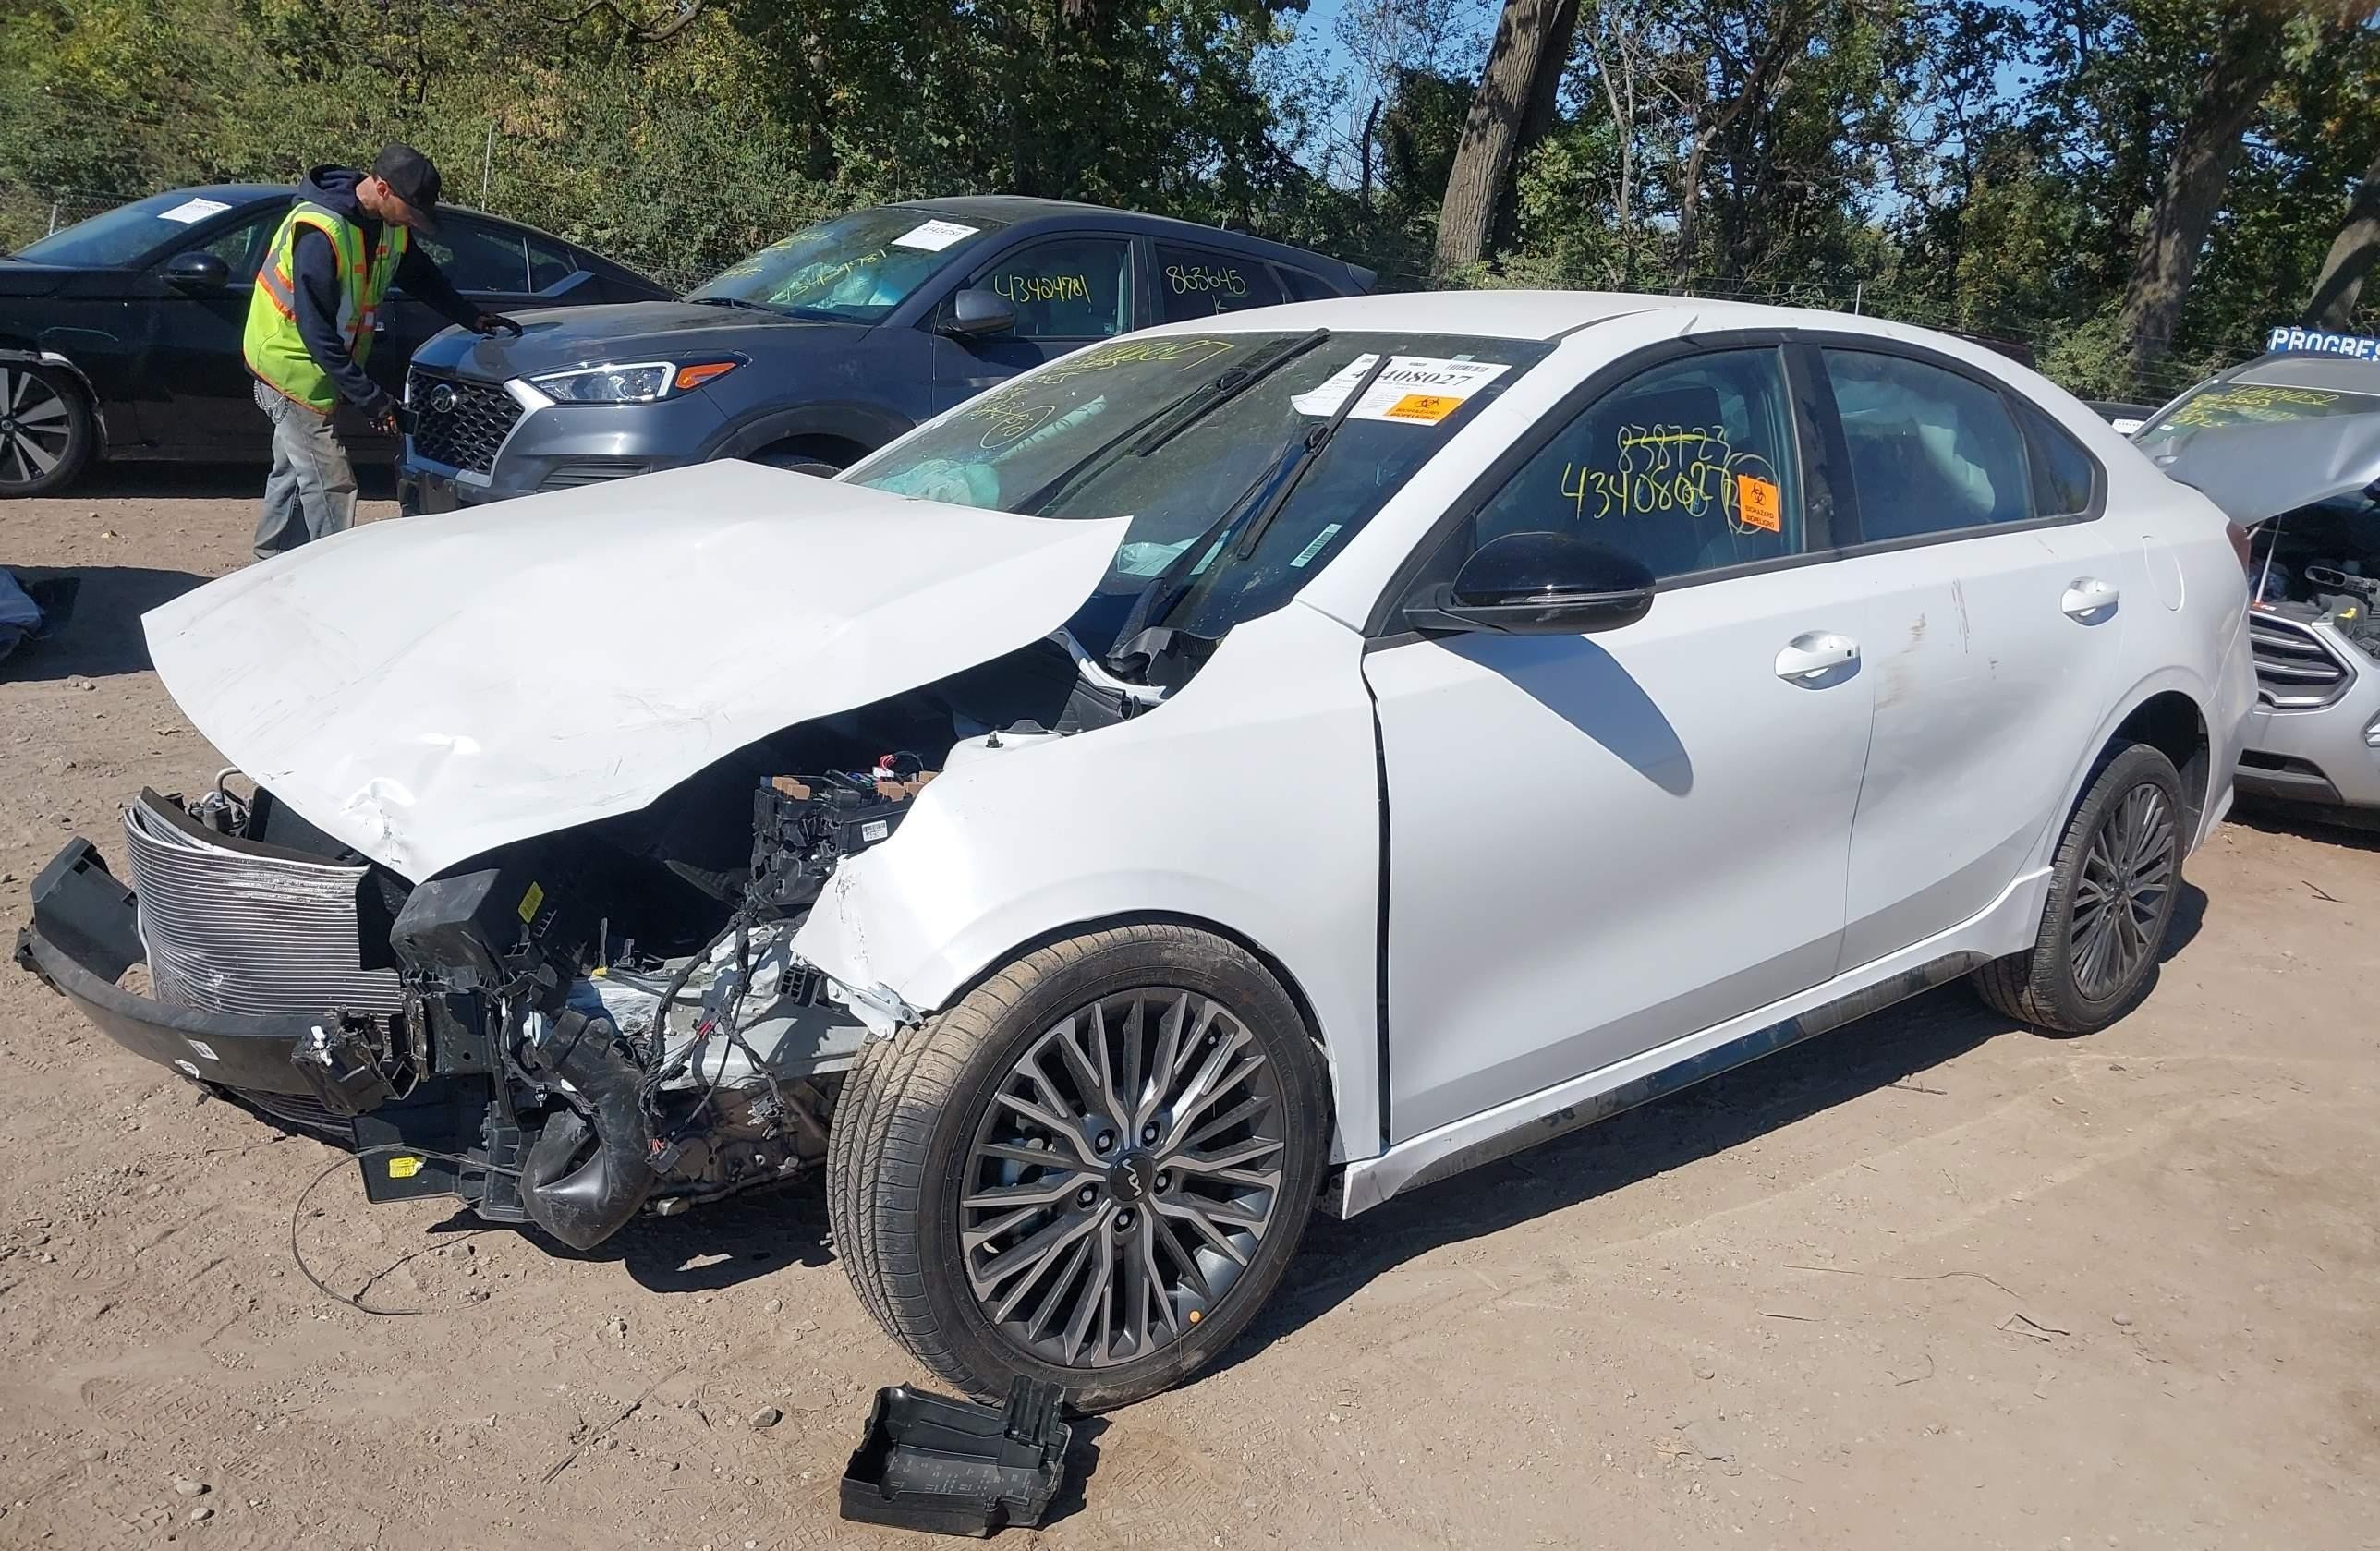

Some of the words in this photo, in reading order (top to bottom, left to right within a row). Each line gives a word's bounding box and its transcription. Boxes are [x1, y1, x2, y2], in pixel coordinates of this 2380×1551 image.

[994, 273, 1092, 304] 43424781
[1166, 264, 1247, 295] 863645
[1351, 368, 1475, 386] 4408027
[1618, 423, 1731, 474] 838723
[1560, 461, 1731, 520] 43408027
[1744, 504, 1774, 519] BIOHAZARD
